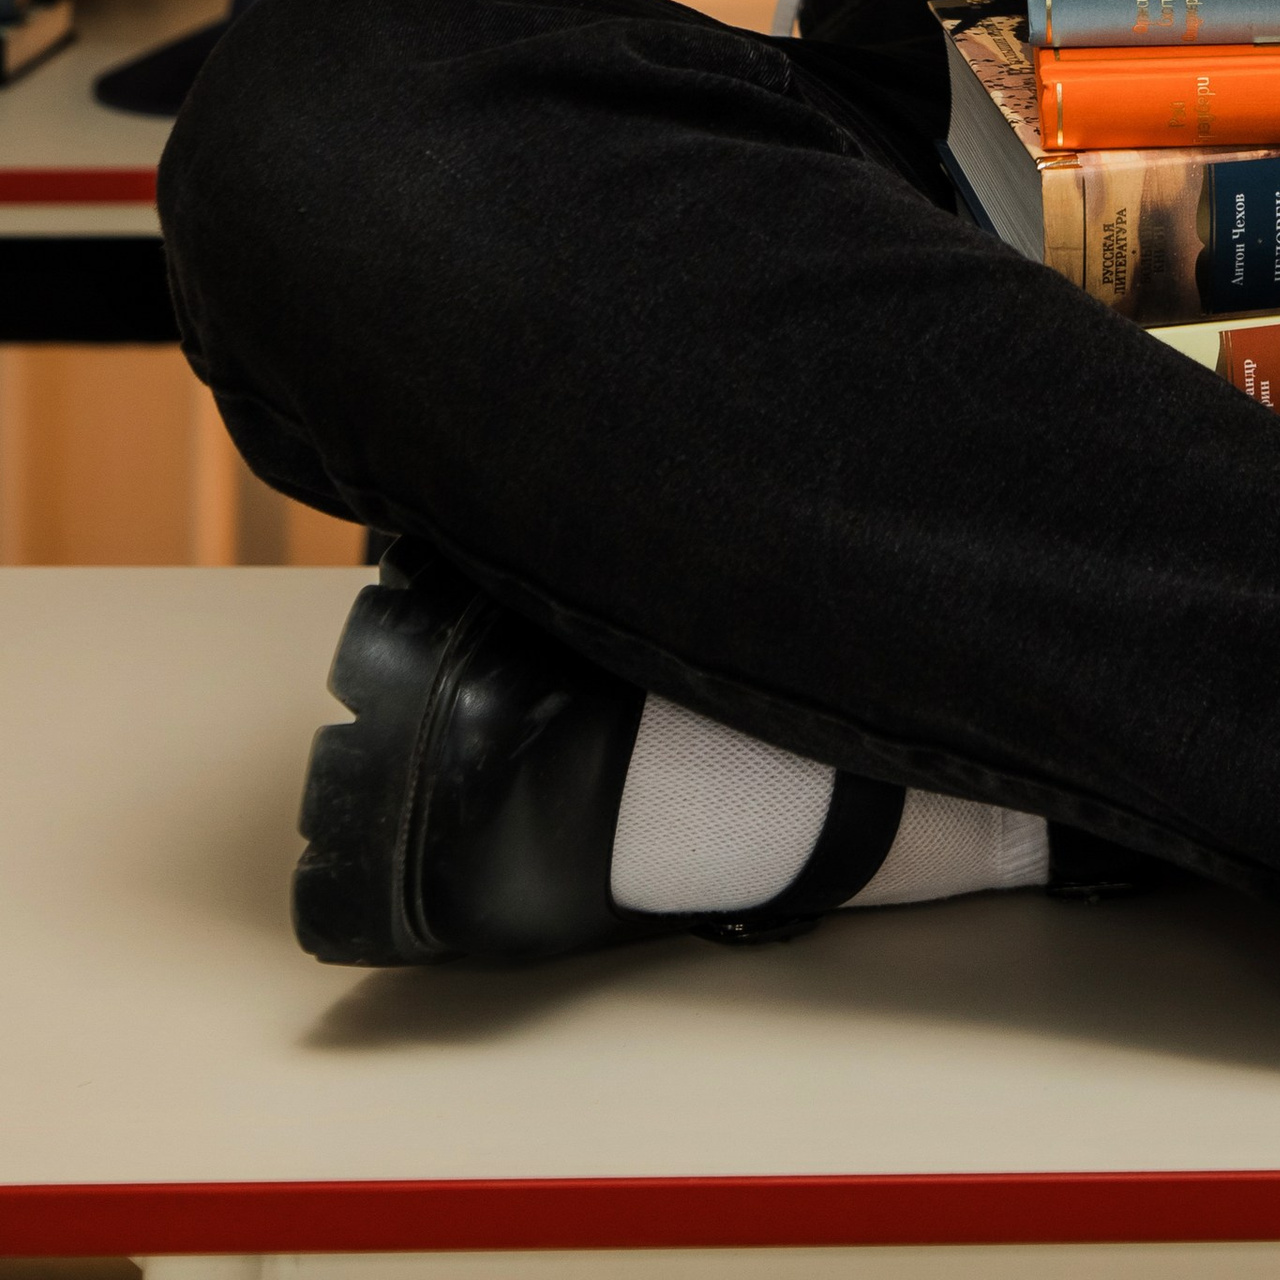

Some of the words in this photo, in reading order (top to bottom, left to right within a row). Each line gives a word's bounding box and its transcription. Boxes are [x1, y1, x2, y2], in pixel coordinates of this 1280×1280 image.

[1232, 193, 1245, 240] Чехов
[1102, 222, 1115, 286] РУССКАЯ
[1114, 207, 1127, 296] ЛИТЕРАТУРА
[1231, 243, 1245, 286] Антон
[1260, 380, 1274, 408] рин
